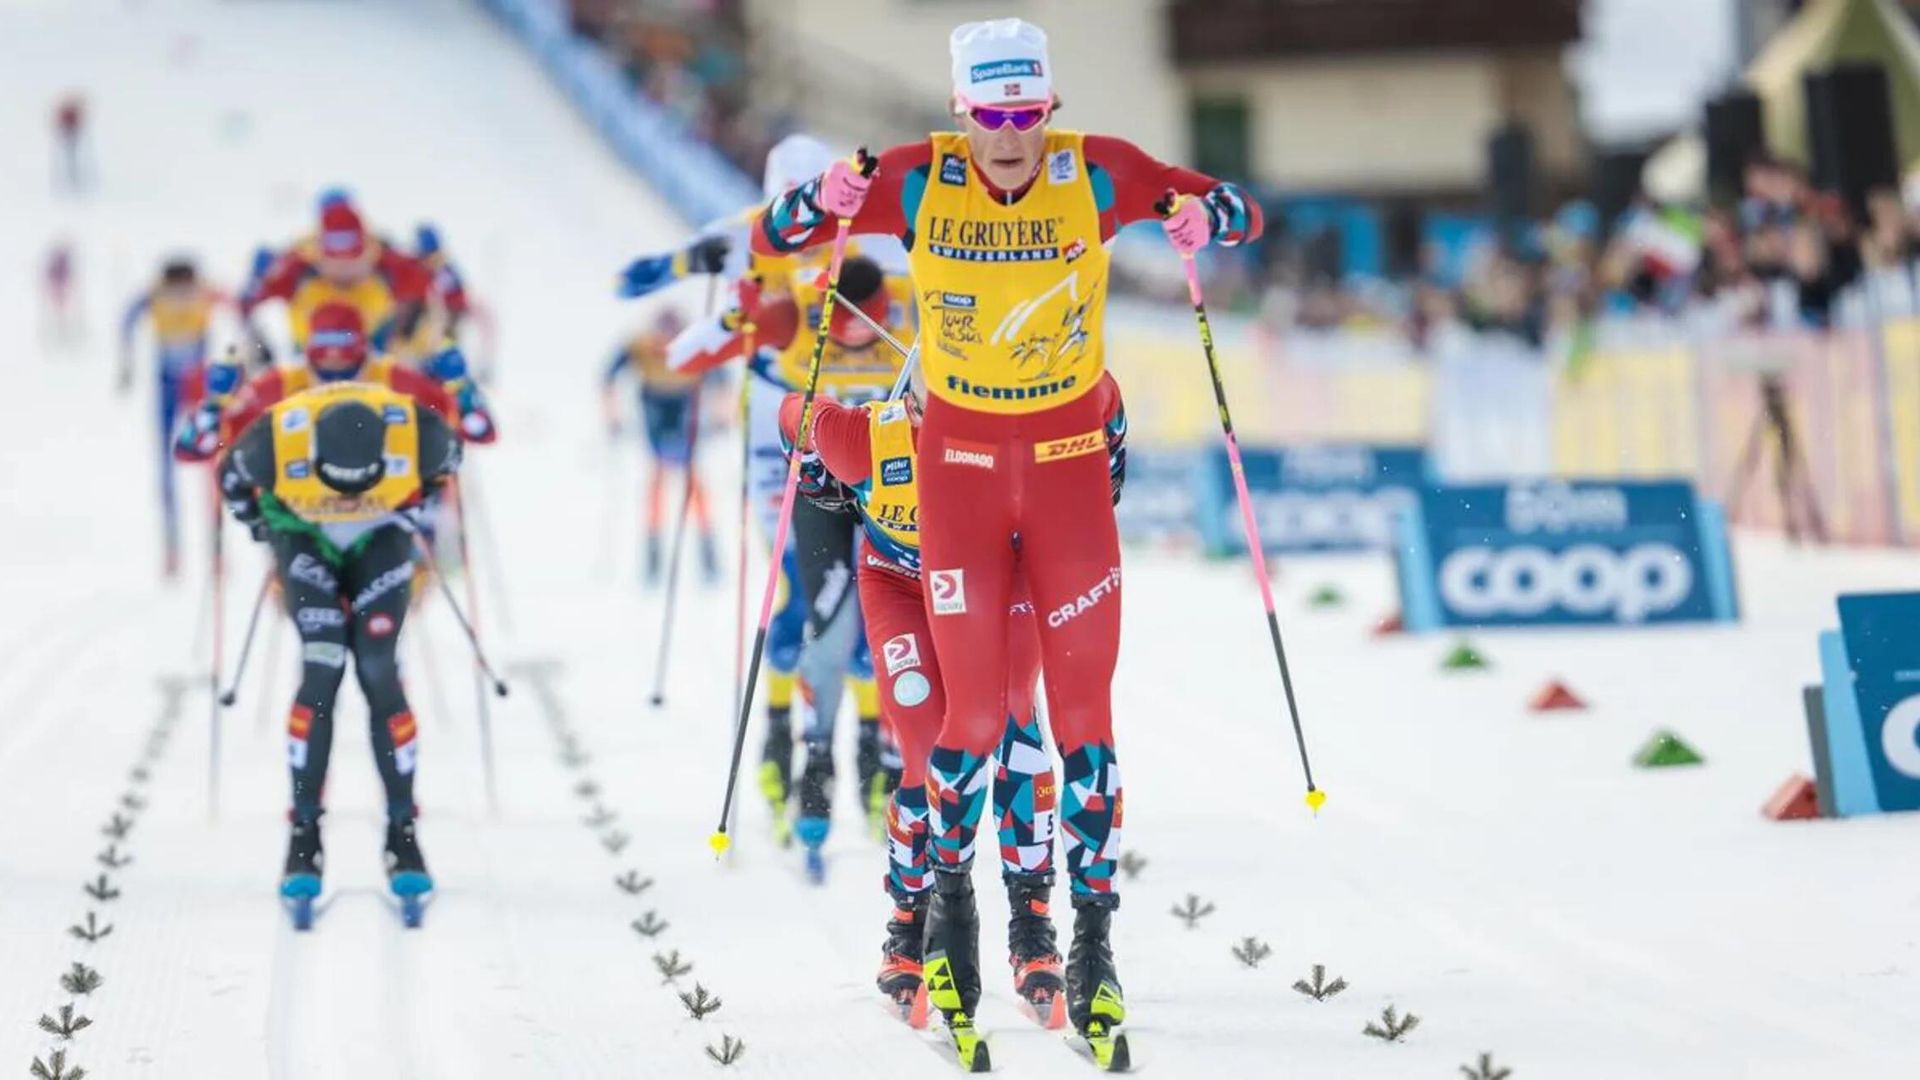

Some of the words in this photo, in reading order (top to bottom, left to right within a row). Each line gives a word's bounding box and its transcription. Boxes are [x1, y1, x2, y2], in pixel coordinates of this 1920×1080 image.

[929, 216, 953, 243] LE
[932, 246, 1055, 261] SWITZERLAND
[947, 375, 1076, 400] fiemme
[1046, 434, 1099, 457] DHL
[944, 448, 994, 469] ELDORADO
[880, 504, 905, 522] LE
[1439, 543, 1693, 623] coop
[1047, 575, 1113, 628] CRAFT
